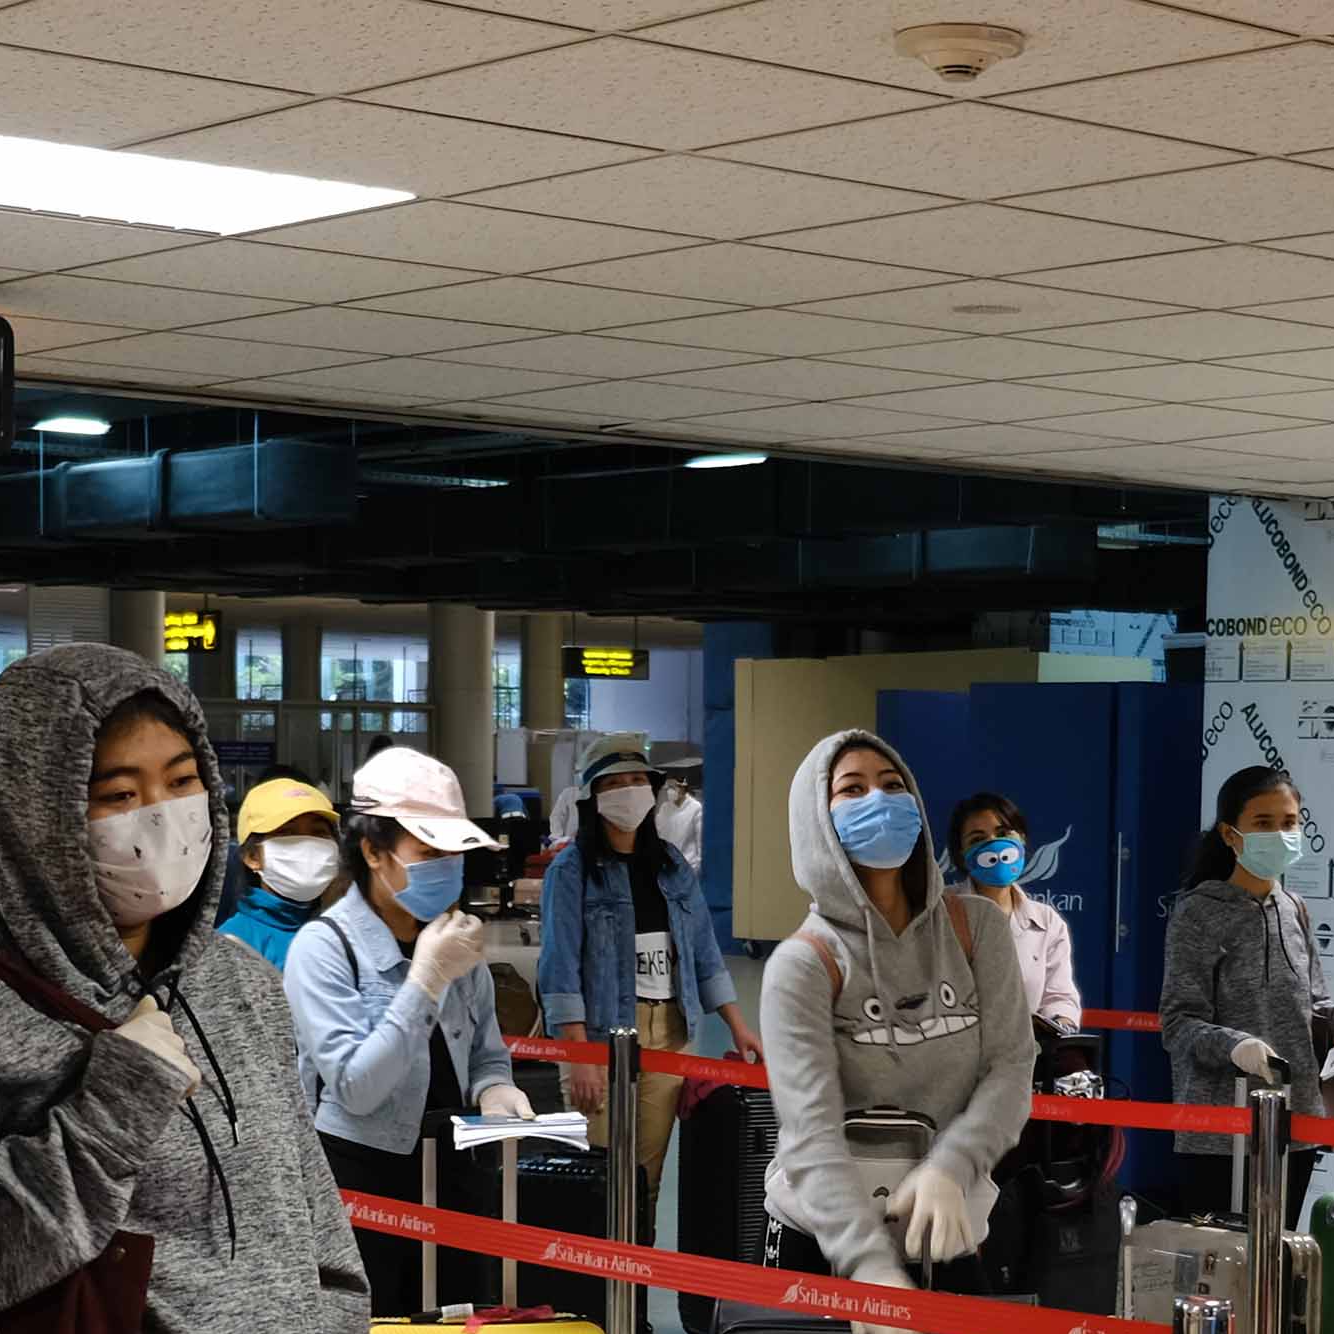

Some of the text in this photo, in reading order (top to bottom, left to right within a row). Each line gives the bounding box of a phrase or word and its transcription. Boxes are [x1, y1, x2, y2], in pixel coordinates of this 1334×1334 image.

[1302, 590, 1331, 634] eco
[1269, 616, 1307, 636] eco
[1205, 701, 1234, 746] eco
[610, 1255, 652, 1278] Airlines
[862, 1297, 912, 1321] Airlines
